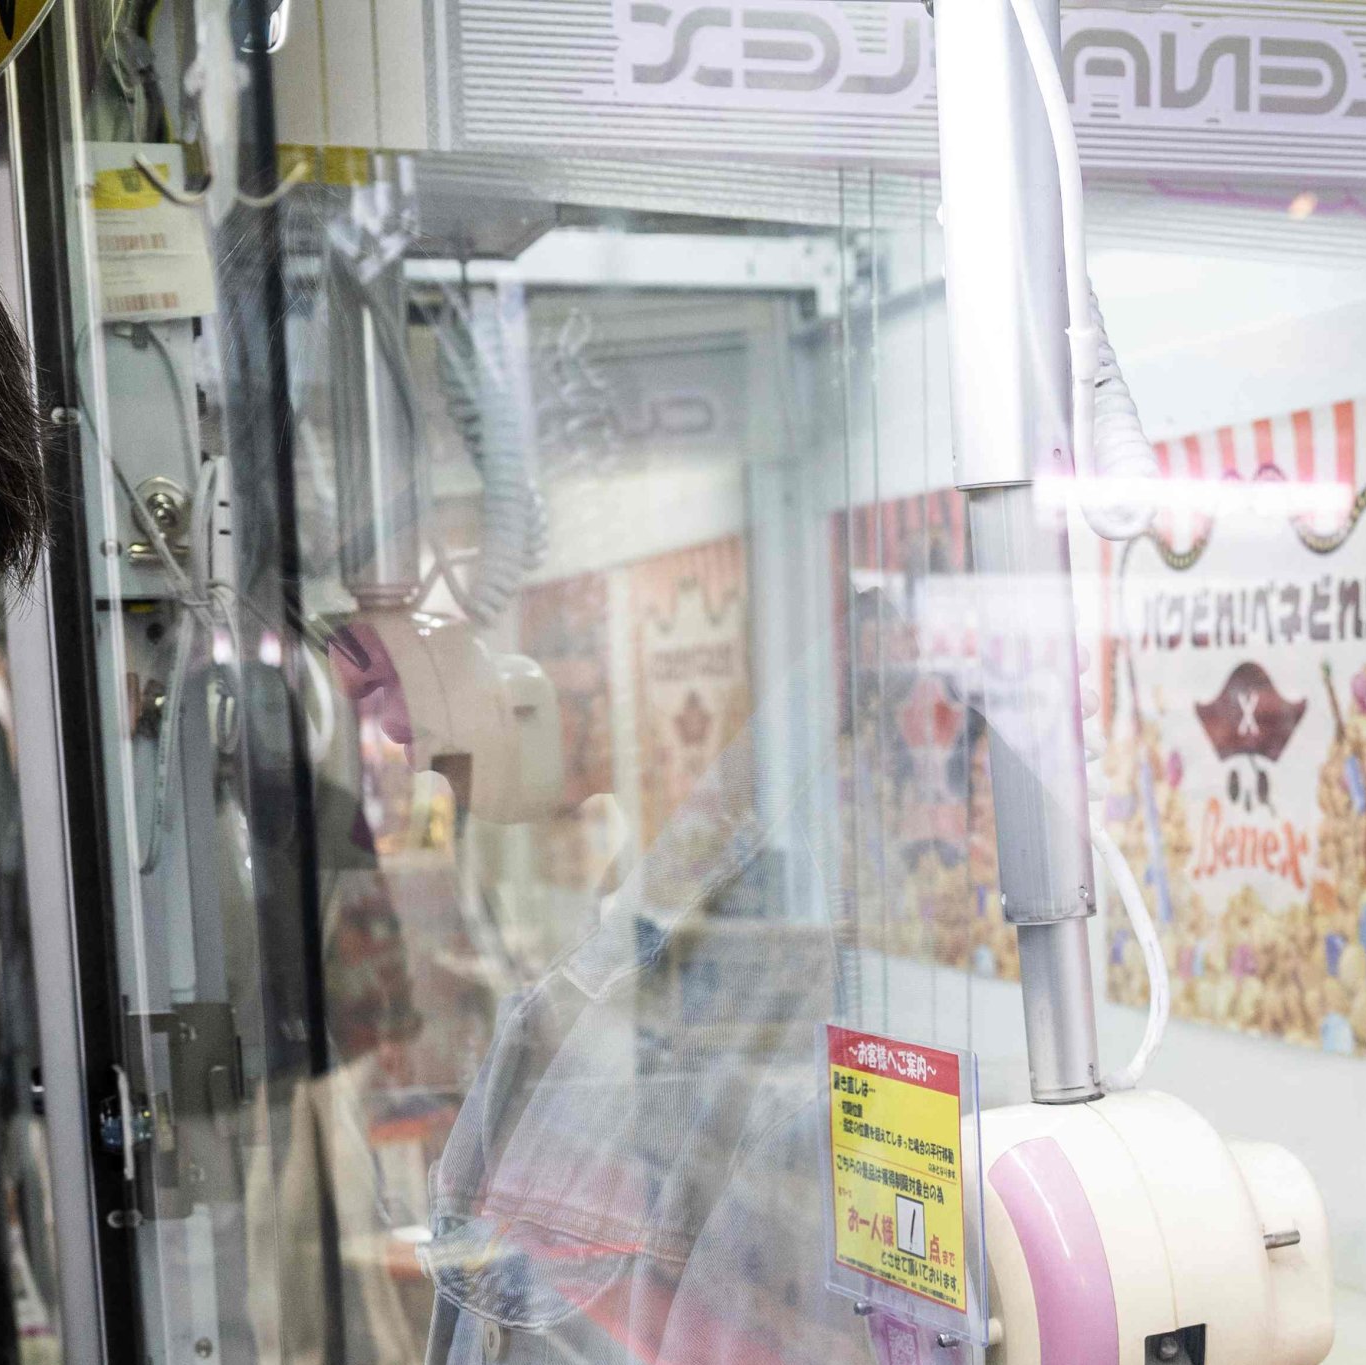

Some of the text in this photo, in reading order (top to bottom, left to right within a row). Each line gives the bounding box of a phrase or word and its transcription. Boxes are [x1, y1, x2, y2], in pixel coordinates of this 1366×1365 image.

[1193, 796, 1310, 890] Benex
[847, 1205, 894, 1248] お一人様
